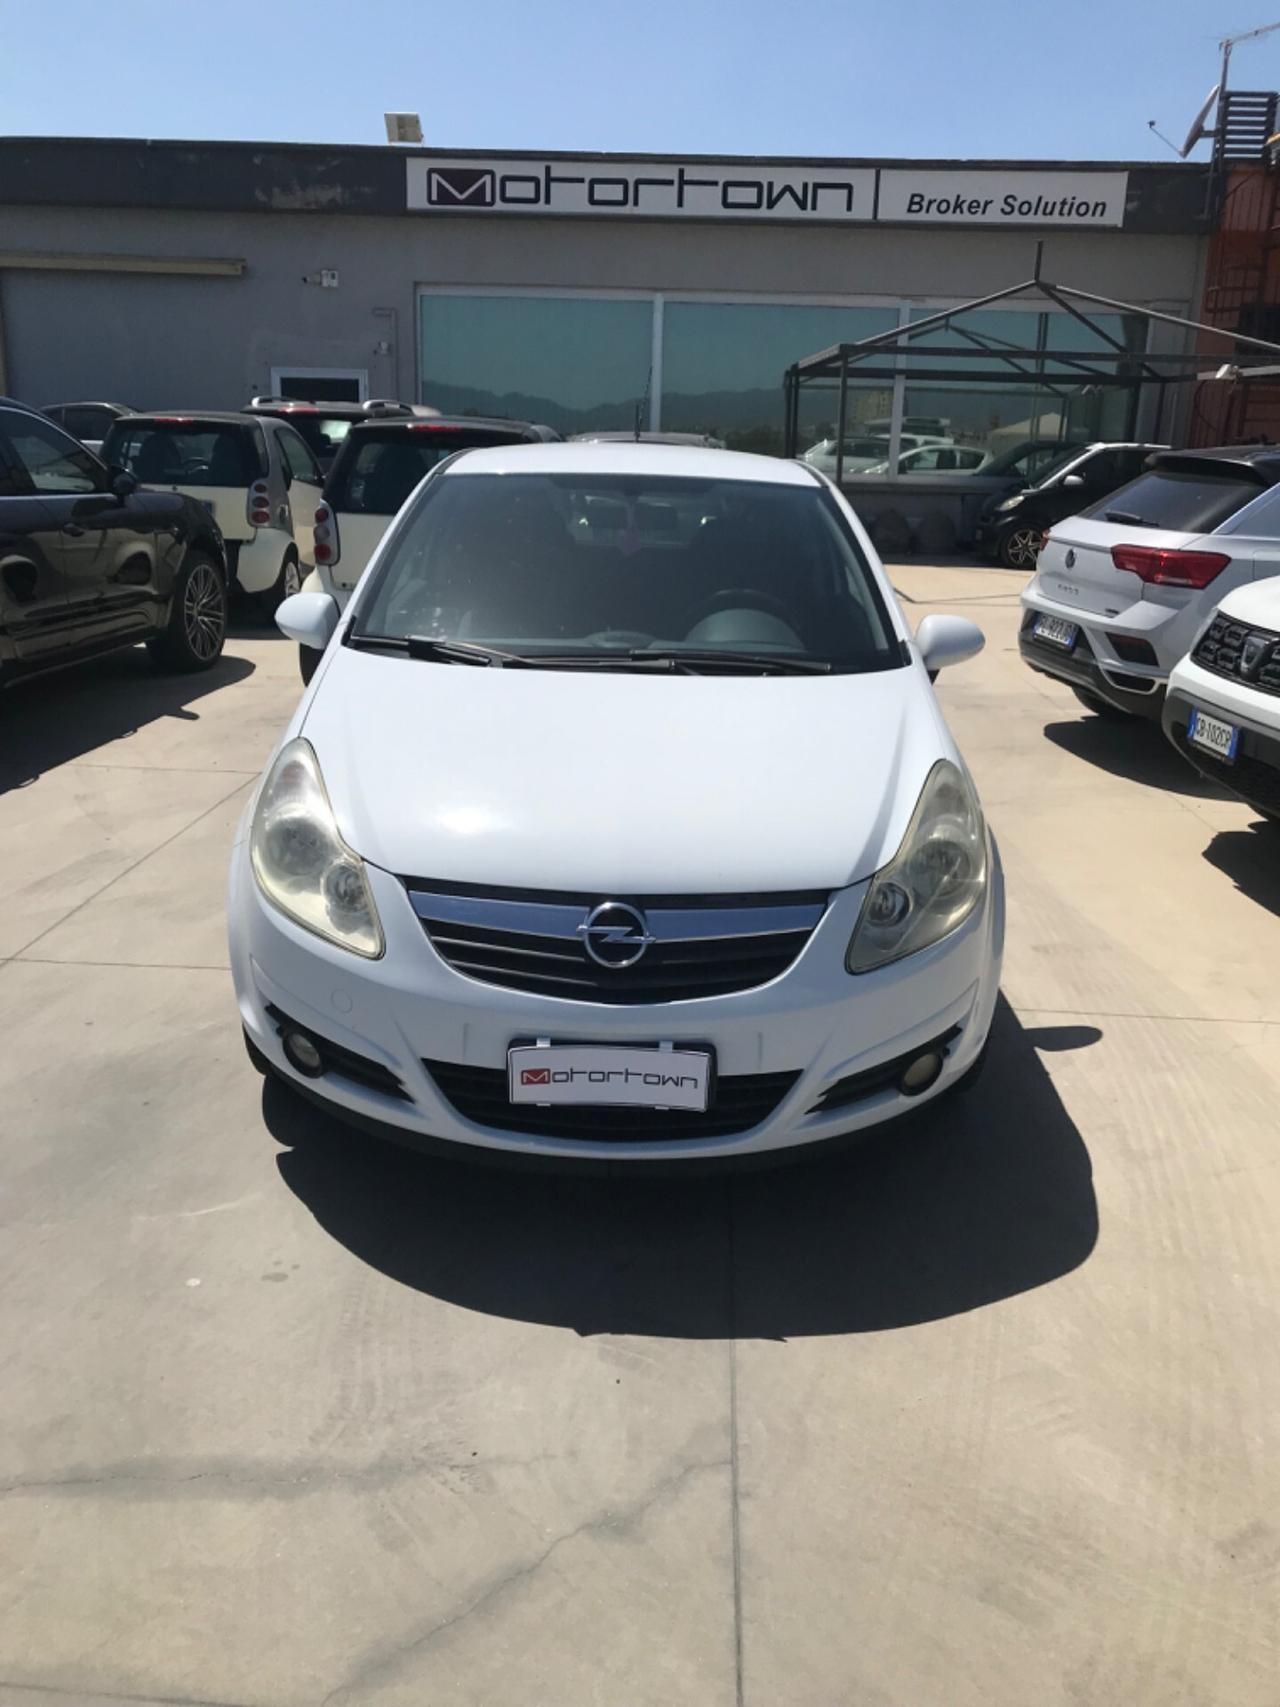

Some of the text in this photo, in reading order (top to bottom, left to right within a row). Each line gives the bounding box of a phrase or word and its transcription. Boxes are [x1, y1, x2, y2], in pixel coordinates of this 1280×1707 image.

[427, 165, 853, 212] Motortown
[906, 193, 1107, 217] Broker Solution
[521, 1067, 698, 1089] Motortown
